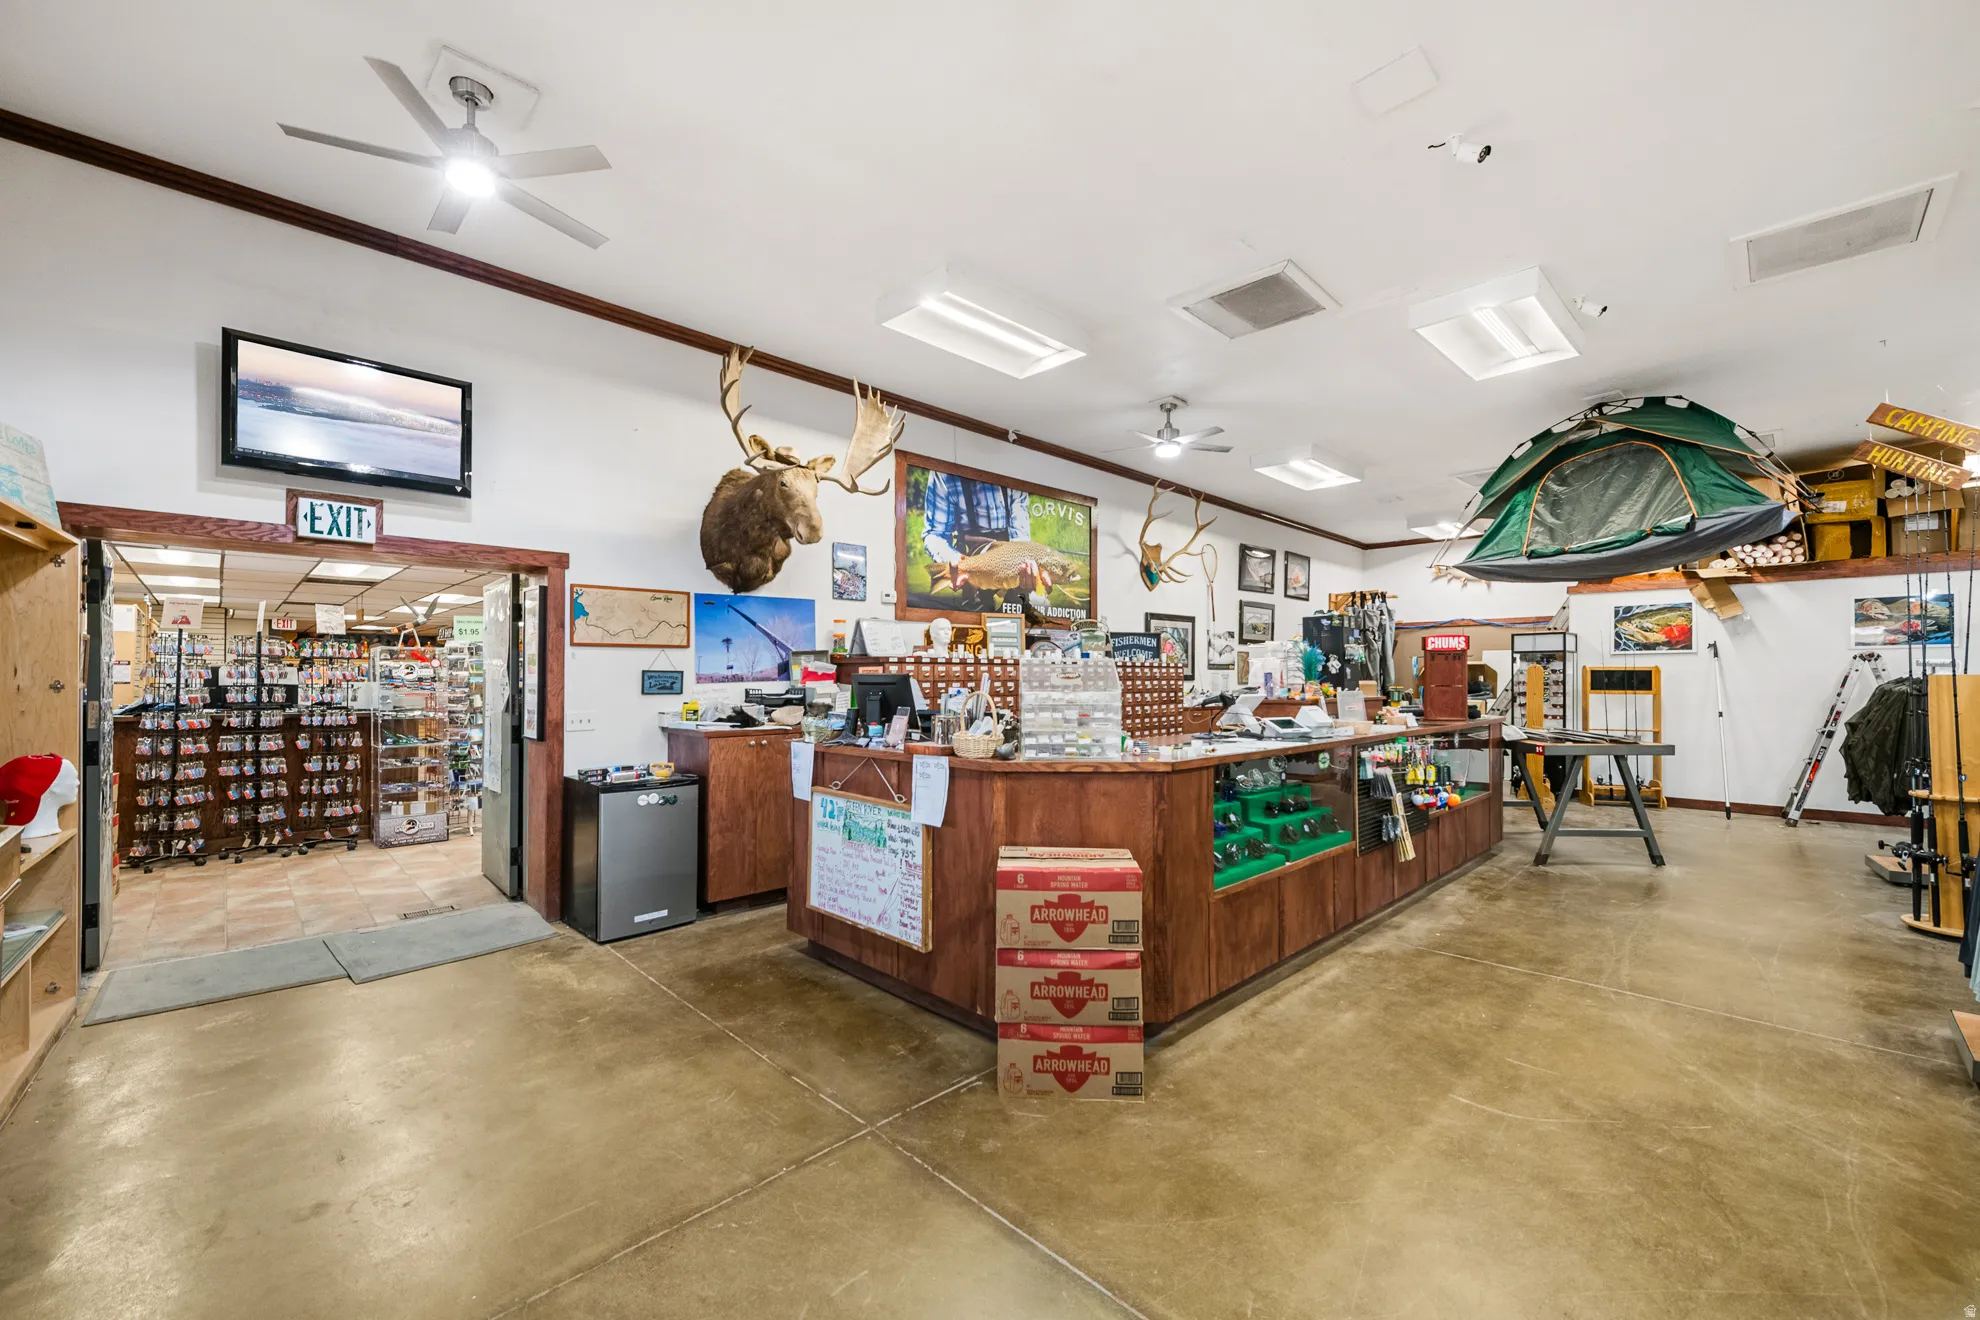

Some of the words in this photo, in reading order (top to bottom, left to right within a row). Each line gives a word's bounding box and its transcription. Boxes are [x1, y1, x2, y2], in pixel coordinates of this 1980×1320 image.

[1885, 409, 1980, 446] CAMPING
[1866, 445, 1960, 484] HUNTING
[310, 501, 367, 539] EXIT
[1031, 502, 1085, 526] ORVIS
[1002, 603, 1022, 614] FEED
[1047, 607, 1086, 619] ADDICTION
[277, 619, 293, 628] EXIT
[458, 628, 479, 636] $1.95
[1111, 635, 1157, 647] FISHERMEN
[1428, 636, 1466, 649] CHUMS
[1114, 648, 1154, 660] WELCOME
[1017, 873, 1024, 884] 6
[1033, 908, 1106, 921] ARROWHEAD
[1017, 950, 1024, 961] 6
[1033, 985, 1106, 999] ARROWHEAD
[1020, 1023, 1027, 1033] 6
[1035, 1059, 1108, 1073] ARROWHEAD
